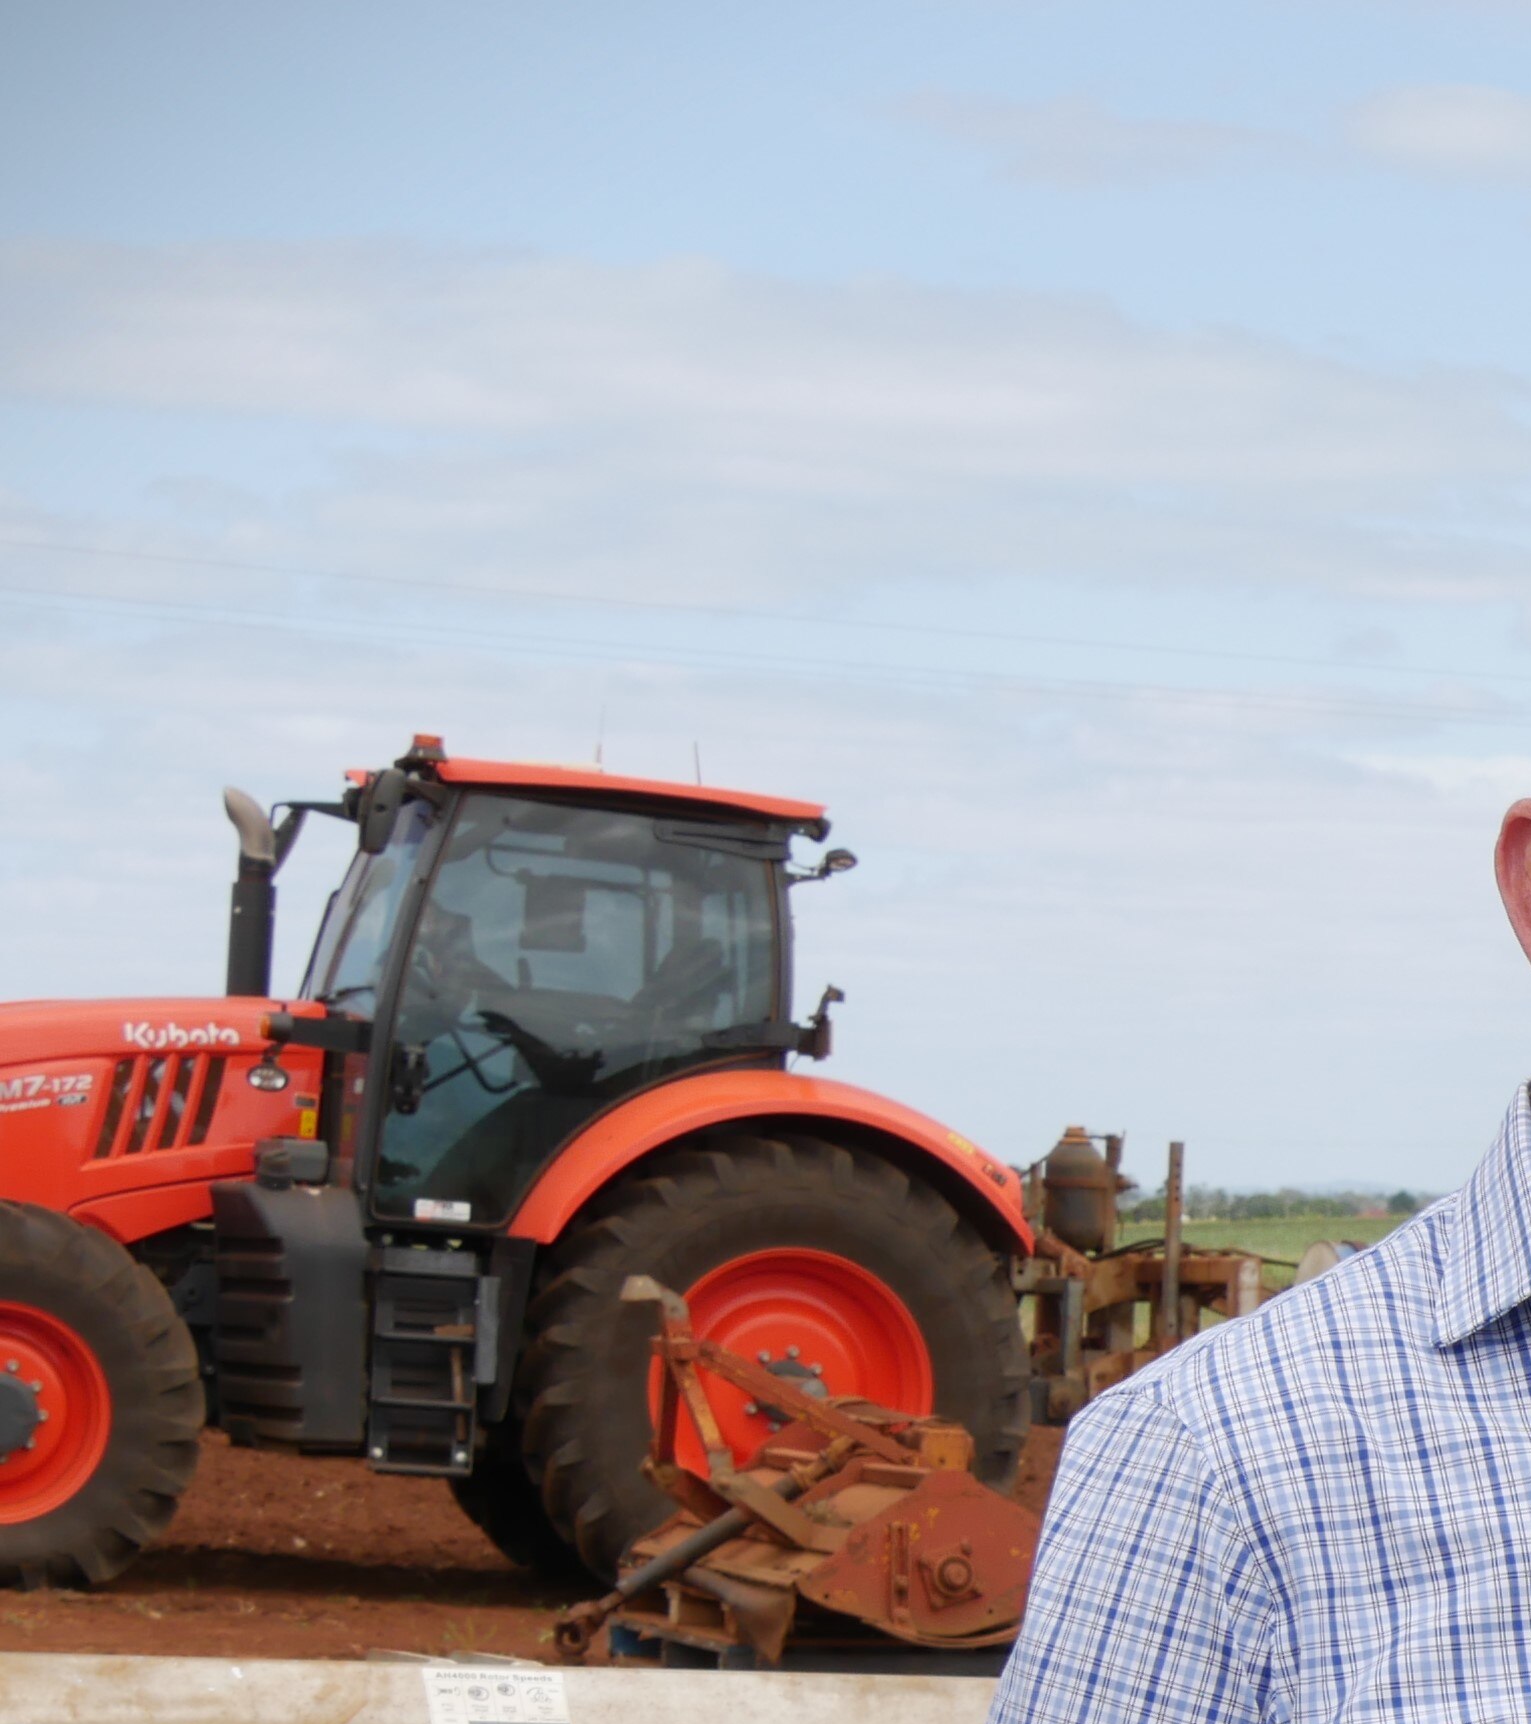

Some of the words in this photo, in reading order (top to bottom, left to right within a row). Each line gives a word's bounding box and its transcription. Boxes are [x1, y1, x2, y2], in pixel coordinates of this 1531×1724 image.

[123, 1021, 240, 1049] Kubota
[479, 1672, 510, 1681] Rotor
[512, 1673, 553, 1683] Speeds
